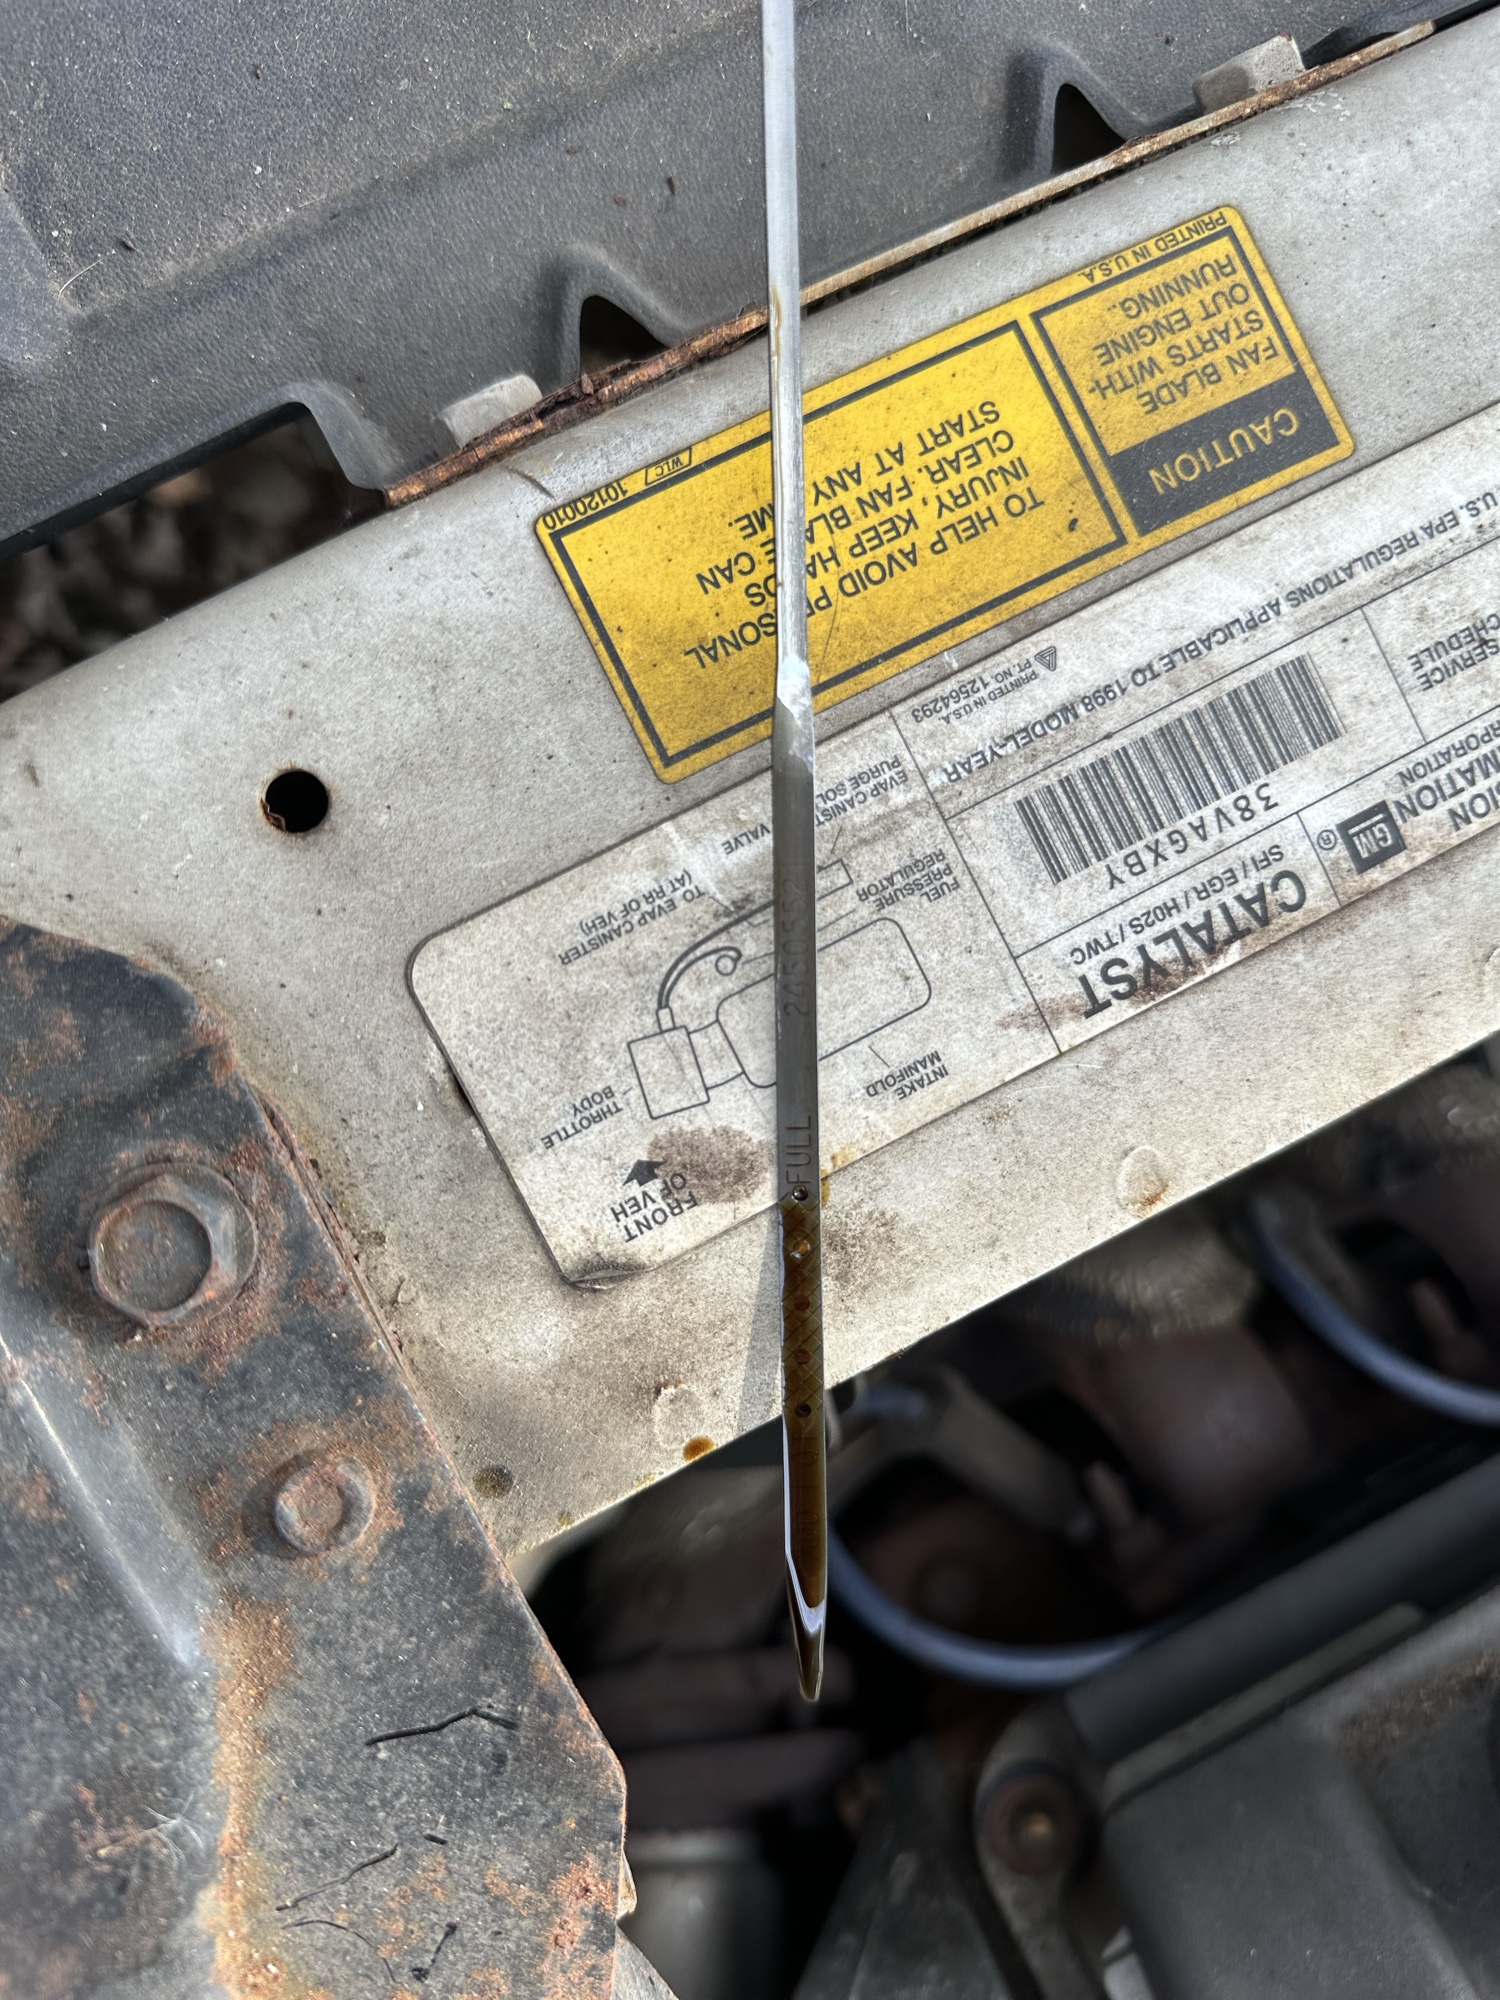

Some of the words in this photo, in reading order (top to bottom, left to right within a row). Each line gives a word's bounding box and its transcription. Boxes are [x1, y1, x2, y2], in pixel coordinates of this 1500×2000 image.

[1151, 207, 1227, 252] PRINTED
[1077, 255, 1130, 283] U.S.A.
[1131, 244, 1152, 263] IN
[1198, 282, 1250, 321] OUT
[1092, 307, 1192, 367] ENGINE
[1166, 309, 1264, 367] STARTS
[1225, 336, 1279, 376] FAN
[1088, 356, 1164, 400] WITH-
[1136, 362, 1222, 415] BLADE
[917, 401, 1000, 457] START
[874, 441, 904, 477] AT
[917, 430, 1014, 484] CLEAR.
[1148, 408, 1299, 494] CAUTION
[538, 477, 628, 534] 10120010
[803, 462, 862, 507] ANY
[855, 475, 913, 518] FAN
[922, 456, 1029, 519] INJURY,
[1003, 487, 1045, 518] TO
[1459, 492, 1500, 518] U.S.
[759, 505, 852, 566] BLAE
[849, 508, 919, 558] KEEP
[929, 506, 999, 555] HELP
[1419, 509, 1460, 539] EPA
[696, 552, 756, 595] CAN
[744, 546, 841, 607] HADS
[838, 542, 918, 598] AVOID
[1285, 530, 1420, 608] REGULATIONS
[681, 586, 833, 669] PSONAL
[1158, 597, 1281, 673] APPLICABLE
[988, 670, 1038, 701] PRINTED
[991, 667, 1013, 684] NO.
[1012, 658, 1032, 674] PT.
[1131, 660, 1162, 687] TO
[1417, 638, 1500, 691] SERVICE
[911, 675, 990, 723] 12564293
[938, 703, 973, 725] U.S.A.
[973, 696, 987, 709] IN
[1079, 679, 1127, 713] 1998
[941, 701, 1080, 787] MODEL-YEAR
[847, 754, 902, 791] PURGE
[867, 768, 909, 798] EVAP
[1393, 745, 1500, 823] MATION
[809, 791, 867, 828] CANIST
[1448, 778, 1500, 831] ION
[722, 823, 771, 855] VALVE
[1105, 783, 1279, 890] 38VAGXBY
[1250, 844, 1284, 872] SFI
[642, 885, 667, 905] RR
[666, 869, 692, 894] (AT
[682, 885, 705, 904] TO
[856, 848, 946, 902] REGULATOR
[872, 863, 953, 913] PRESSURE
[919, 876, 961, 903] FUEL
[1191, 867, 1239, 901] EGR
[579, 911, 618, 937] VEH)
[620, 898, 641, 919] OF
[637, 898, 677, 927] EVAP
[558, 920, 634, 966] CANISTER
[1070, 931, 1117, 965] TWC
[1077, 870, 1307, 1020] CATALYST
[865, 1050, 942, 1097] MANIFOLD
[894, 1064, 949, 1101] INTAKE
[572, 1085, 615, 1118] BODY
[540, 1101, 623, 1150] THROTTLE
[785, 1114, 812, 1184] FULL
[659, 1168, 690, 1200] OF
[610, 1190, 657, 1223] VEH
[623, 1188, 701, 1243] FRONT
